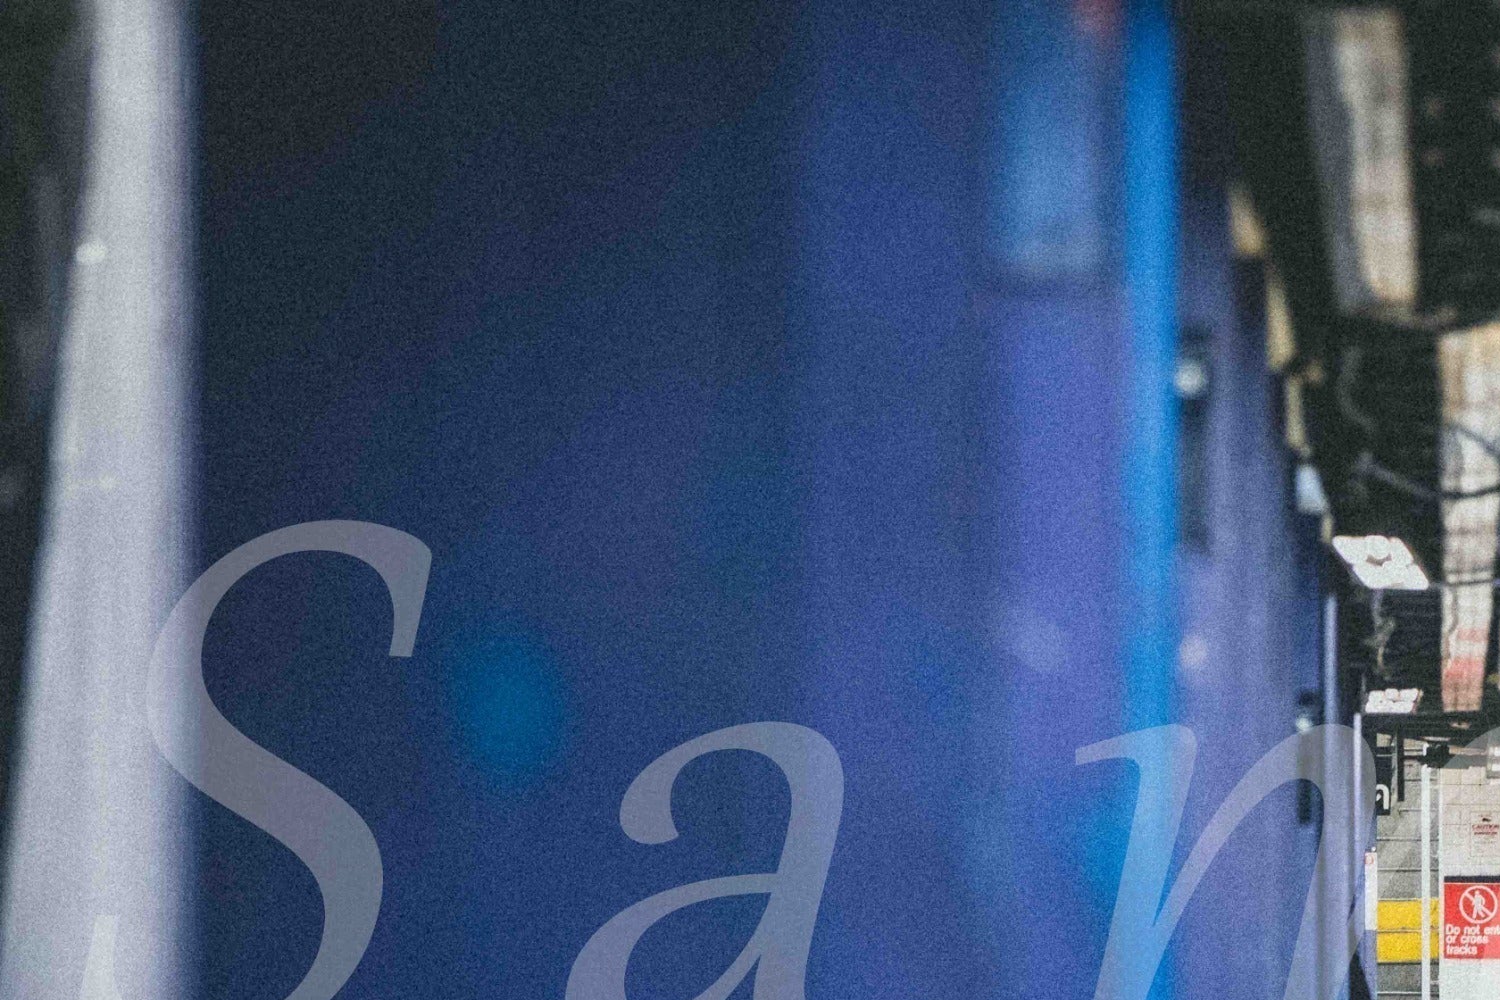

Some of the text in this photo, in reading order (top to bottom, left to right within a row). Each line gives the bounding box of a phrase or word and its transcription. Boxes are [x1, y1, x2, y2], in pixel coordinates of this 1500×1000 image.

[1446, 923, 1461, 935] Do
[1464, 924, 1481, 935] not
[1446, 935, 1489, 944] or cross
[1446, 944, 1478, 955] tracks
